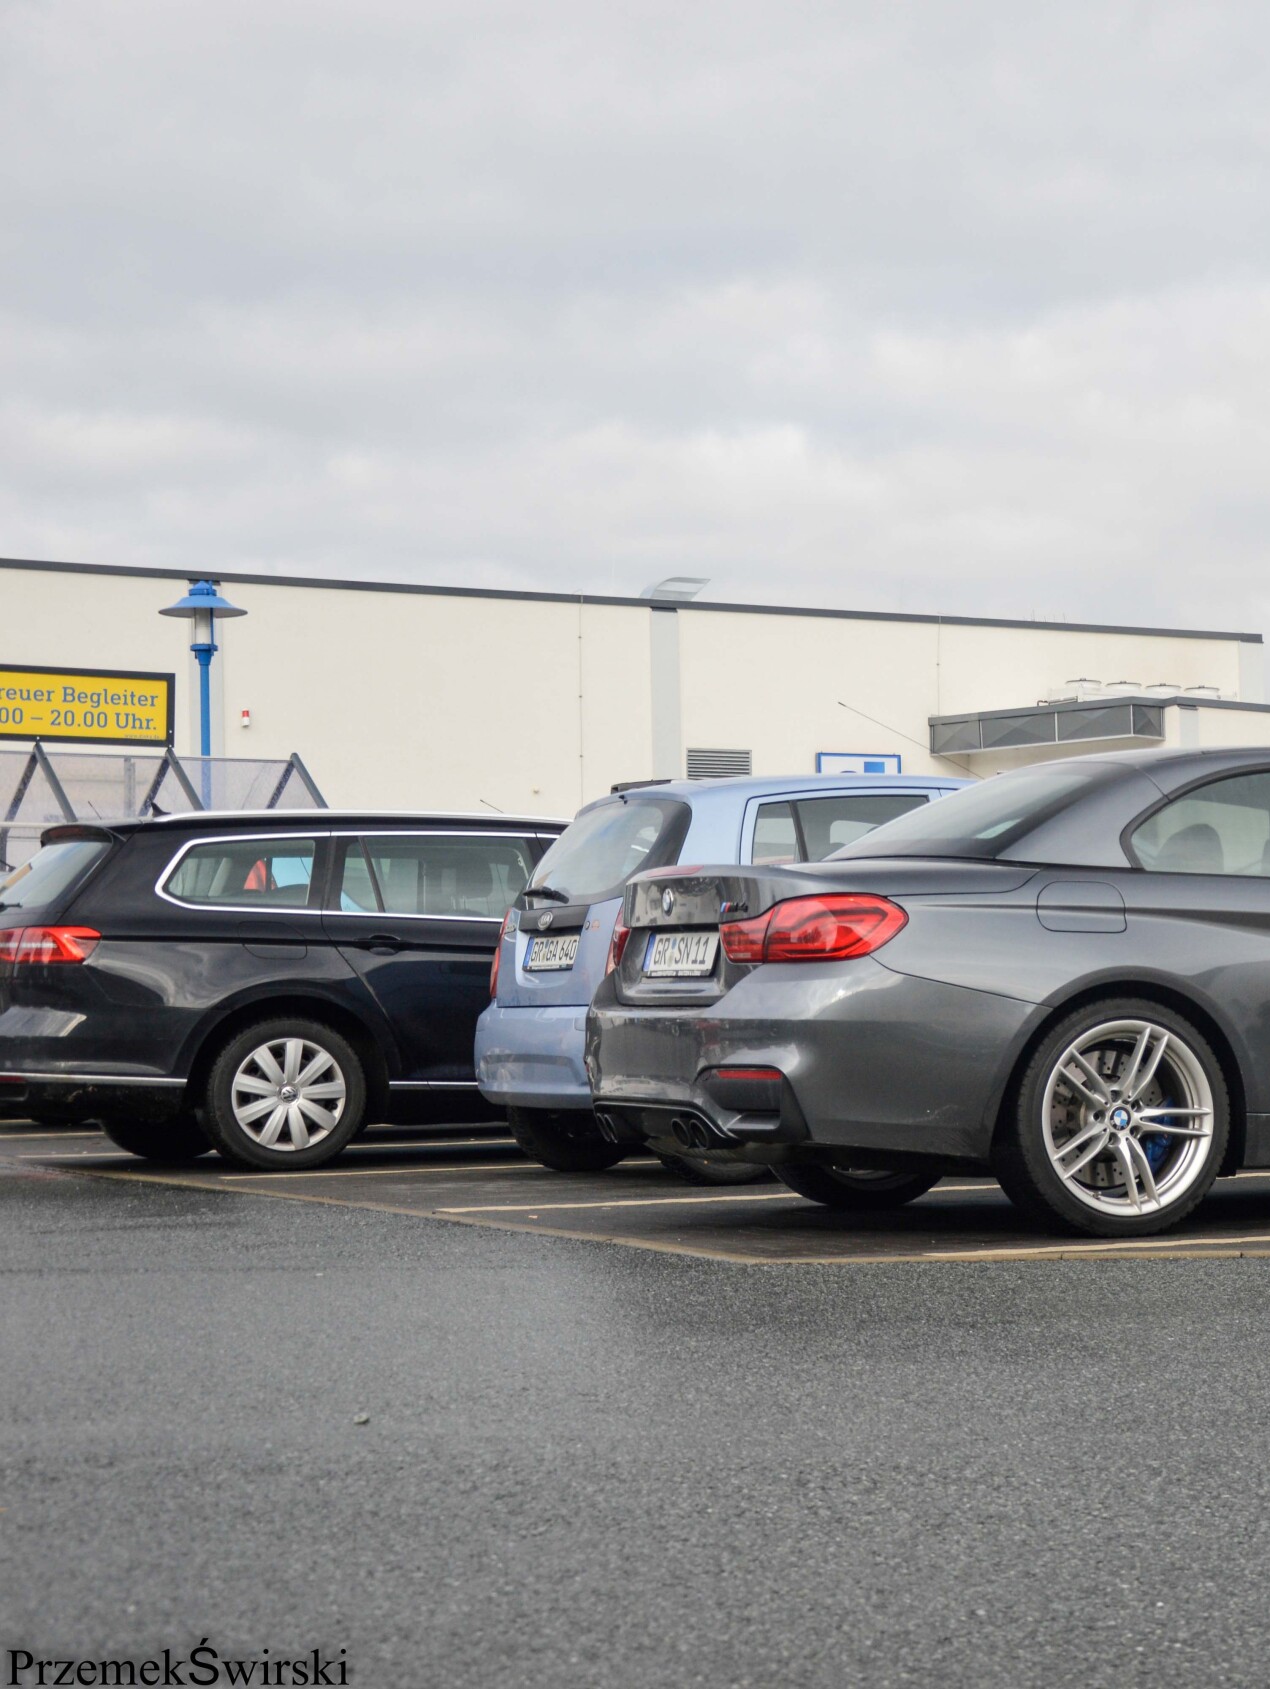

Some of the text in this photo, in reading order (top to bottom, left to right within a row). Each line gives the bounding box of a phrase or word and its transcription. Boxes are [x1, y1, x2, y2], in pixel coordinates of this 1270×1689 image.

[62, 686, 159, 709] Begleiter
[50, 709, 108, 729] 20.00
[115, 712, 157, 731] Uhr.
[530, 942, 545, 962] GR
[653, 938, 671, 966] GR
